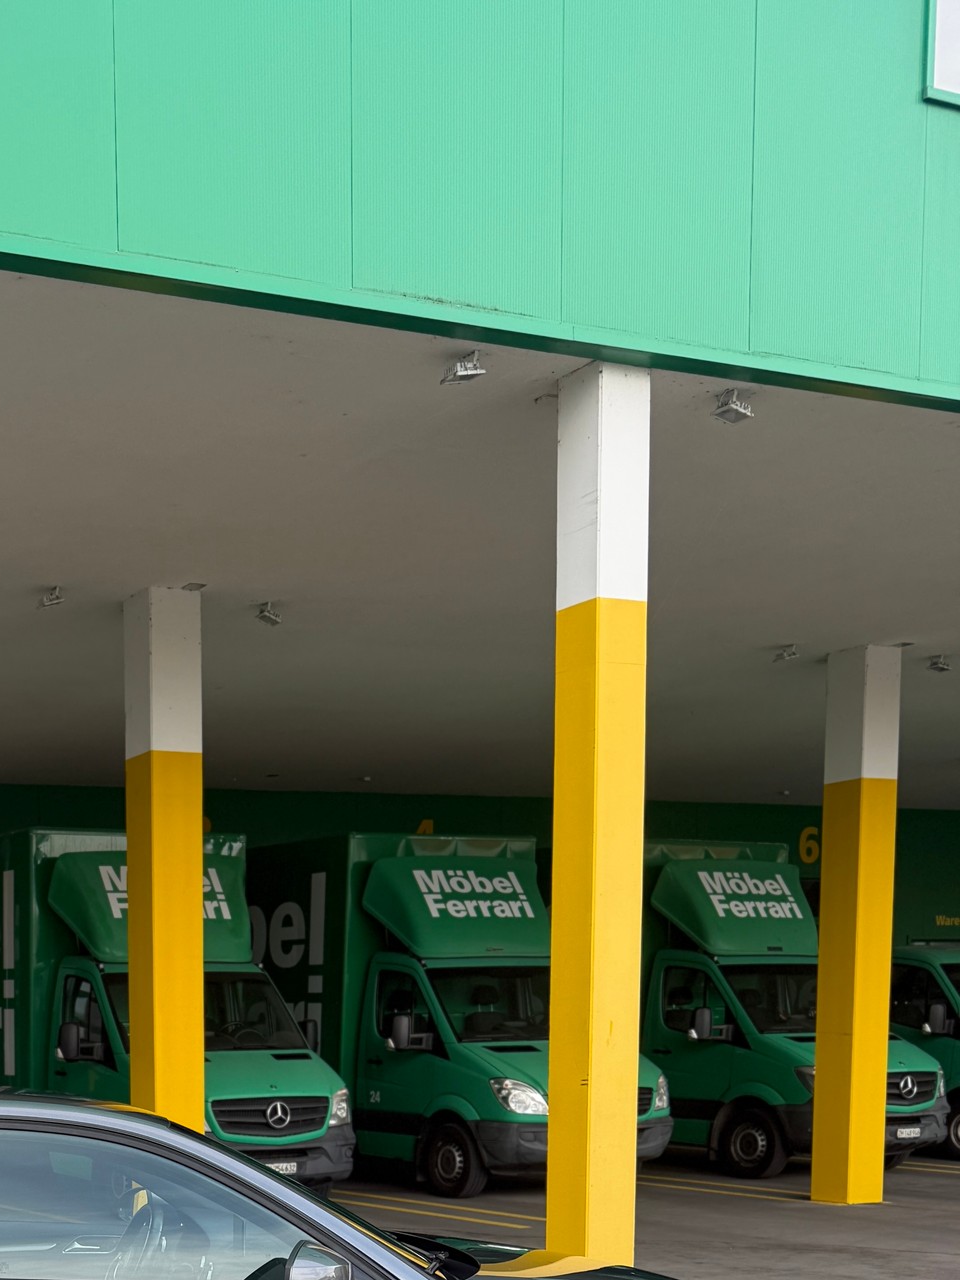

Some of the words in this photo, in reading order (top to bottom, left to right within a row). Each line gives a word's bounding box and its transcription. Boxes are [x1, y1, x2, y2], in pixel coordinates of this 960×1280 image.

[799, 826, 820, 864] 6
[412, 869, 524, 894] Möbel
[697, 871, 792, 896] Möbel
[423, 894, 535, 919] Ferrari
[709, 894, 804, 919] Ferrari
